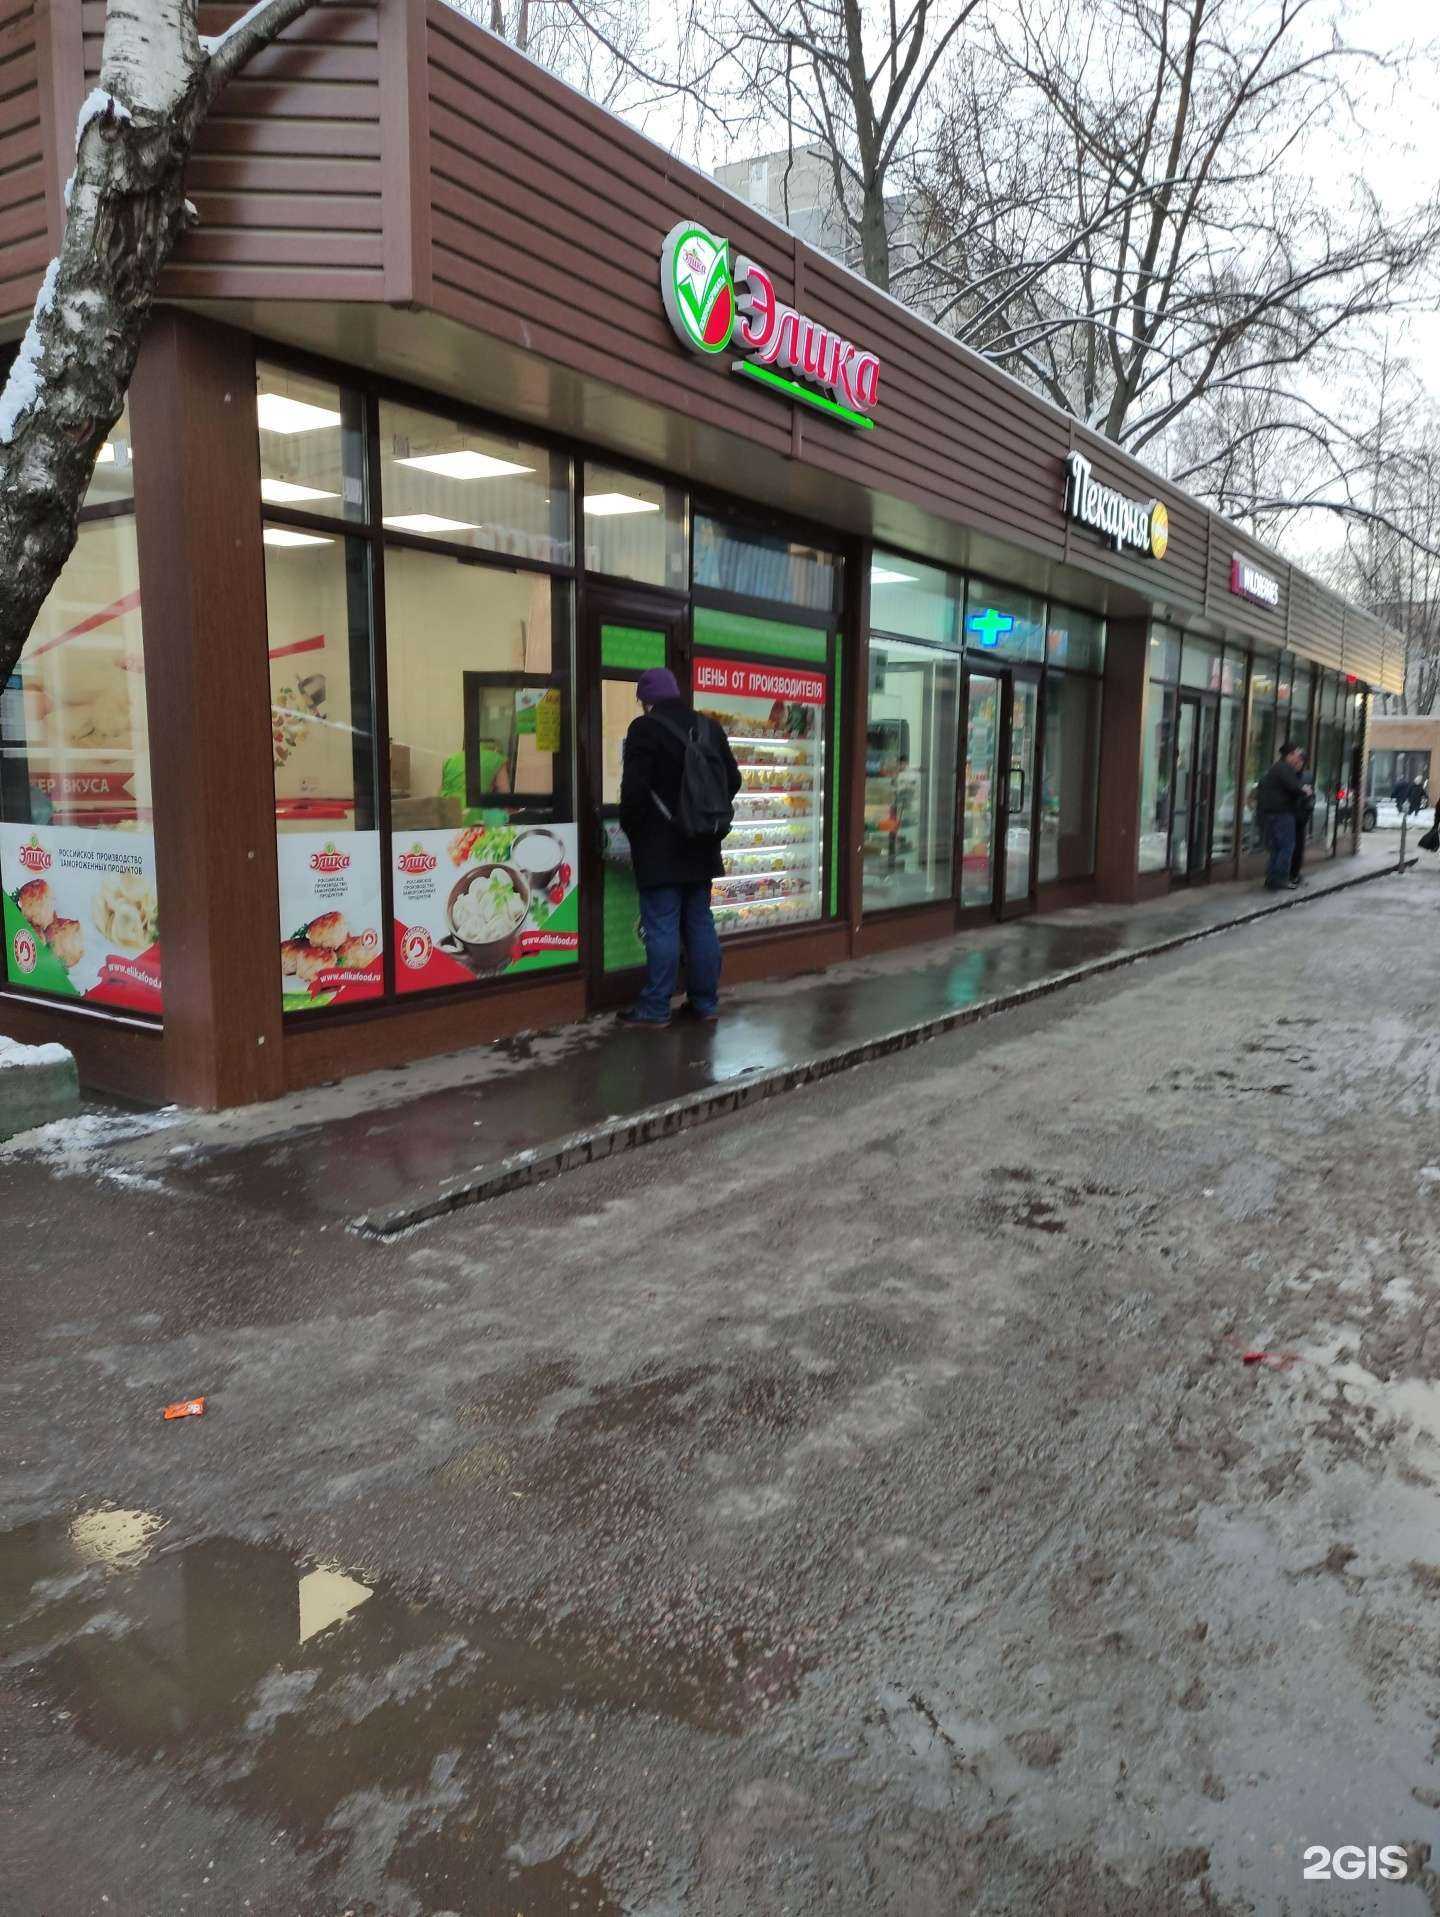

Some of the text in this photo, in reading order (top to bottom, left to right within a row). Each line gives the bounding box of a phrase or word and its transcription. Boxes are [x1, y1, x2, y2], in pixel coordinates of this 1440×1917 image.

[737, 262, 880, 412] Элика
[1071, 452, 1150, 551] Пекарня
[697, 666, 823, 698] ЦЕНЫ ОТ ПРОИЗВОДИТЕЛЯ
[62, 779, 110, 793] ВКУСА
[19, 846, 52, 870] Элика
[97, 852, 143, 865] ПРОИЗВОДСТВО
[310, 854, 351, 870] Элика
[398, 854, 437, 870] Элика
[61, 859, 143, 875] ЗАМОРОЖЕННЫХ ПРОДУКТОВ
[320, 971, 381, 983] www.elikafood.ru
